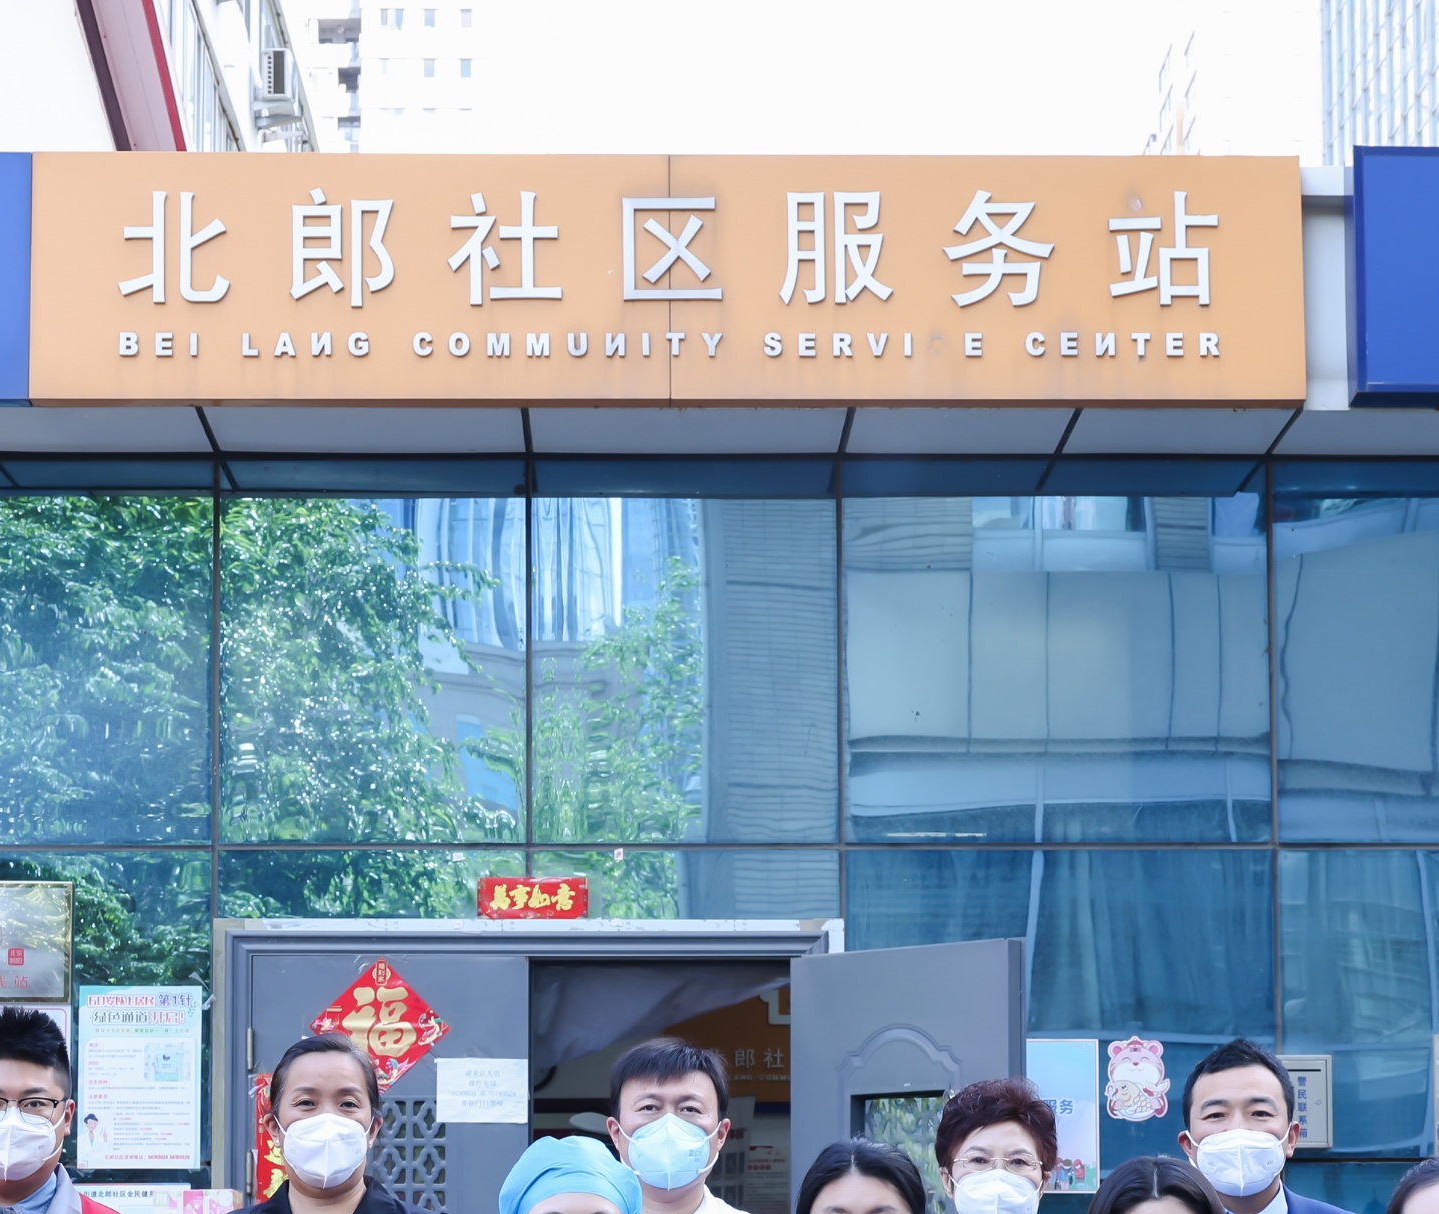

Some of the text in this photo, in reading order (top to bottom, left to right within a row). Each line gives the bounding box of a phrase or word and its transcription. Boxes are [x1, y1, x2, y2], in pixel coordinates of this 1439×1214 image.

[117, 187, 1219, 308] 北郎社区服务站
[118, 331, 1221, 358] BEI LANG COMMUNITY SERVIE CENTER
[342, 986, 417, 1058] 福
